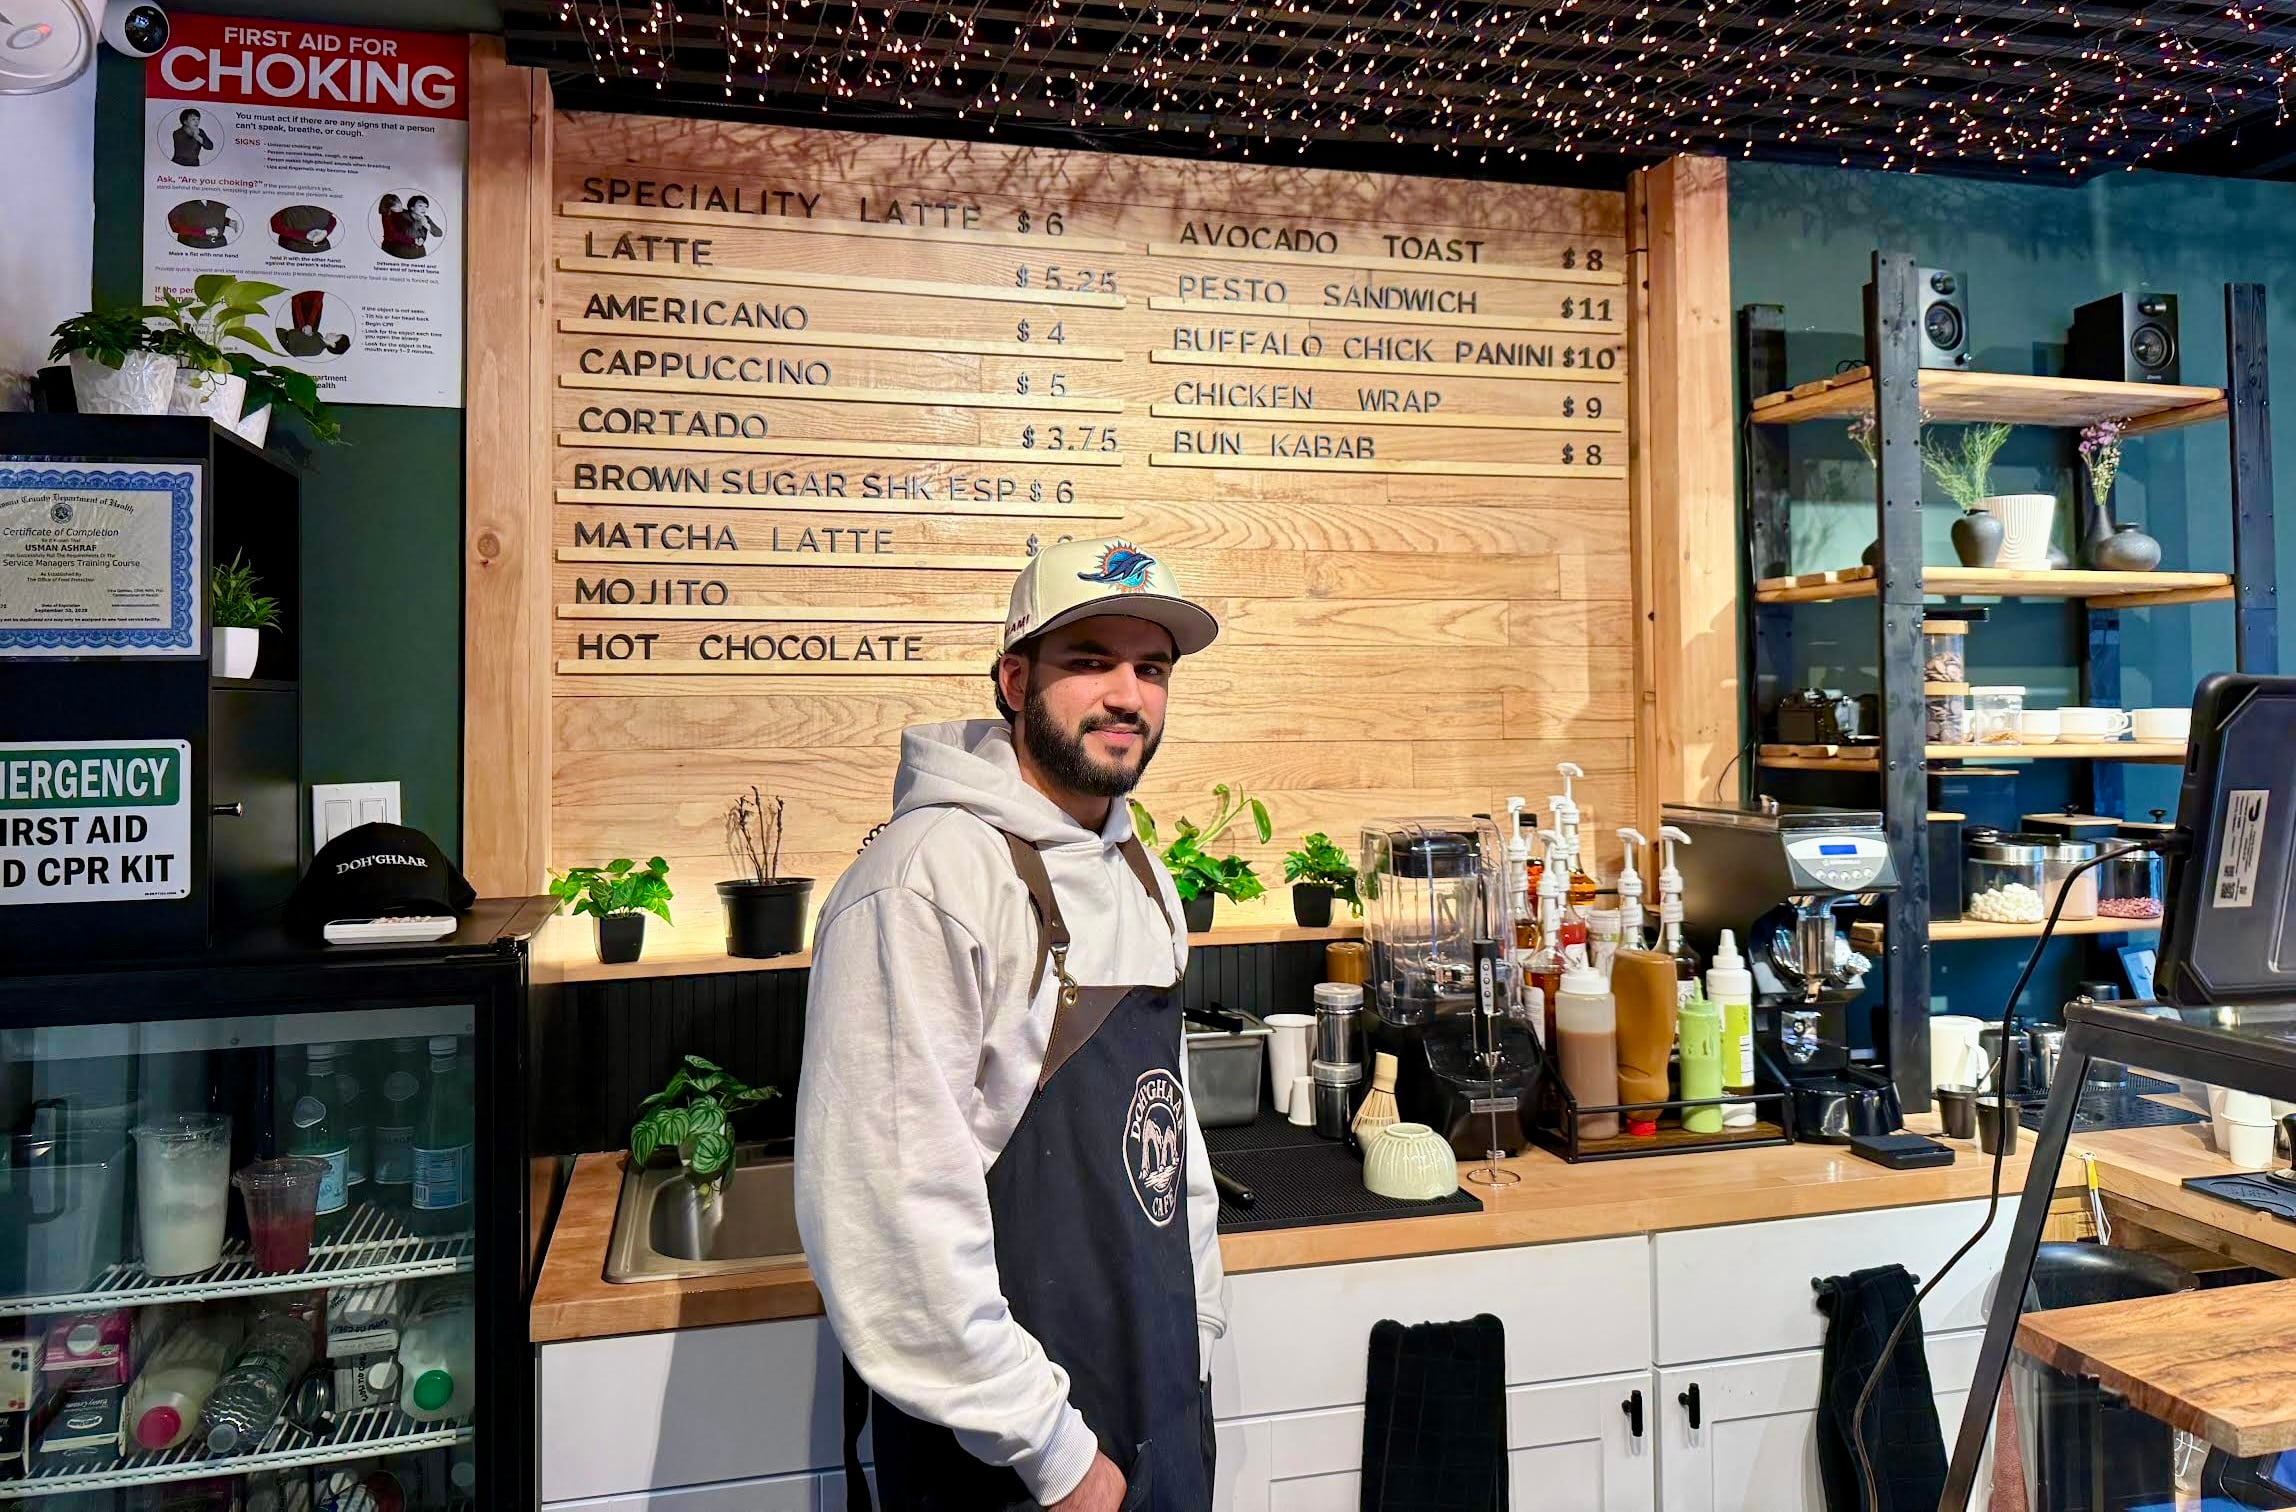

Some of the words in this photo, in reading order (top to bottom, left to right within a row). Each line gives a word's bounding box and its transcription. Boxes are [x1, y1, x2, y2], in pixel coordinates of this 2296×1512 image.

[224, 26, 291, 49] FIRST
[298, 33, 341, 52] AID
[349, 37, 397, 57] FOR
[160, 45, 456, 110] CHOKING
[235, 121, 256, 130] can't
[258, 124, 286, 133] speak,
[288, 124, 323, 135] breathe,
[336, 129, 364, 138] cough.
[236, 111, 252, 121] You
[254, 113, 275, 123] must
[277, 115, 291, 124] act
[292, 115, 299, 123] if
[300, 116, 322, 125] there
[325, 118, 338, 126] are
[340, 119, 355, 128] any
[357, 119, 379, 129] signs
[381, 121, 398, 130] that
[407, 124, 435, 133] person
[235, 138, 261, 146] SIGNS
[199, 178, 216, 187] you
[582, 177, 821, 219] SPECIALITY
[861, 197, 981, 231] LATTE
[1179, 221, 1338, 254] AVOCADO
[1383, 235, 1485, 264] TOAST
[585, 231, 713, 267] LATTE
[1045, 266, 1118, 294] 5.25
[584, 293, 809, 331] AMERICANO
[1179, 274, 1287, 305] PESTO
[1323, 284, 1477, 315] SANDWICH
[1560, 297, 1613, 322] $11
[1173, 326, 1323, 358] BUFFALO
[1343, 335, 1434, 364] CHICK
[1456, 340, 1554, 368] PANINI
[1562, 346, 1616, 371] $10
[580, 348, 831, 386] CAPPUCCINO
[1174, 382, 1313, 410] CHICKEN
[1359, 387, 1441, 413] WRAP
[578, 407, 769, 439] CORTADO
[1047, 427, 1118, 452] 3.75
[1173, 430, 1241, 457] BUN
[1271, 434, 1376, 460] KABAB
[574, 463, 709, 494] BROWN
[722, 469, 847, 499] SUGAR
[862, 473, 934, 500] SHK
[950, 477, 1017, 502] ESP
[3, 527, 52, 536] Certificate
[54, 527, 65, 537] of
[66, 527, 119, 538] Completion
[25, 544, 58, 552] USMAN
[61, 544, 97, 552] ASHRAF
[574, 521, 738, 551] MATCHA
[772, 526, 894, 554] LATTE
[3, 559, 33, 567] Service
[36, 559, 75, 568] Managers
[78, 559, 110, 568] Training
[113, 559, 141, 567] Course
[575, 578, 729, 606] MOJITO
[578, 633, 660, 661] HOT
[699, 634, 923, 662] CHOCOLATE
[0, 757, 170, 802] ERGENCY
[0, 816, 79, 847] IRST
[86, 814, 148, 845] AID
[38, 856, 109, 886] CPR
[121, 854, 174, 883] KIT
[336, 854, 428, 875] DOH'GHAAR
